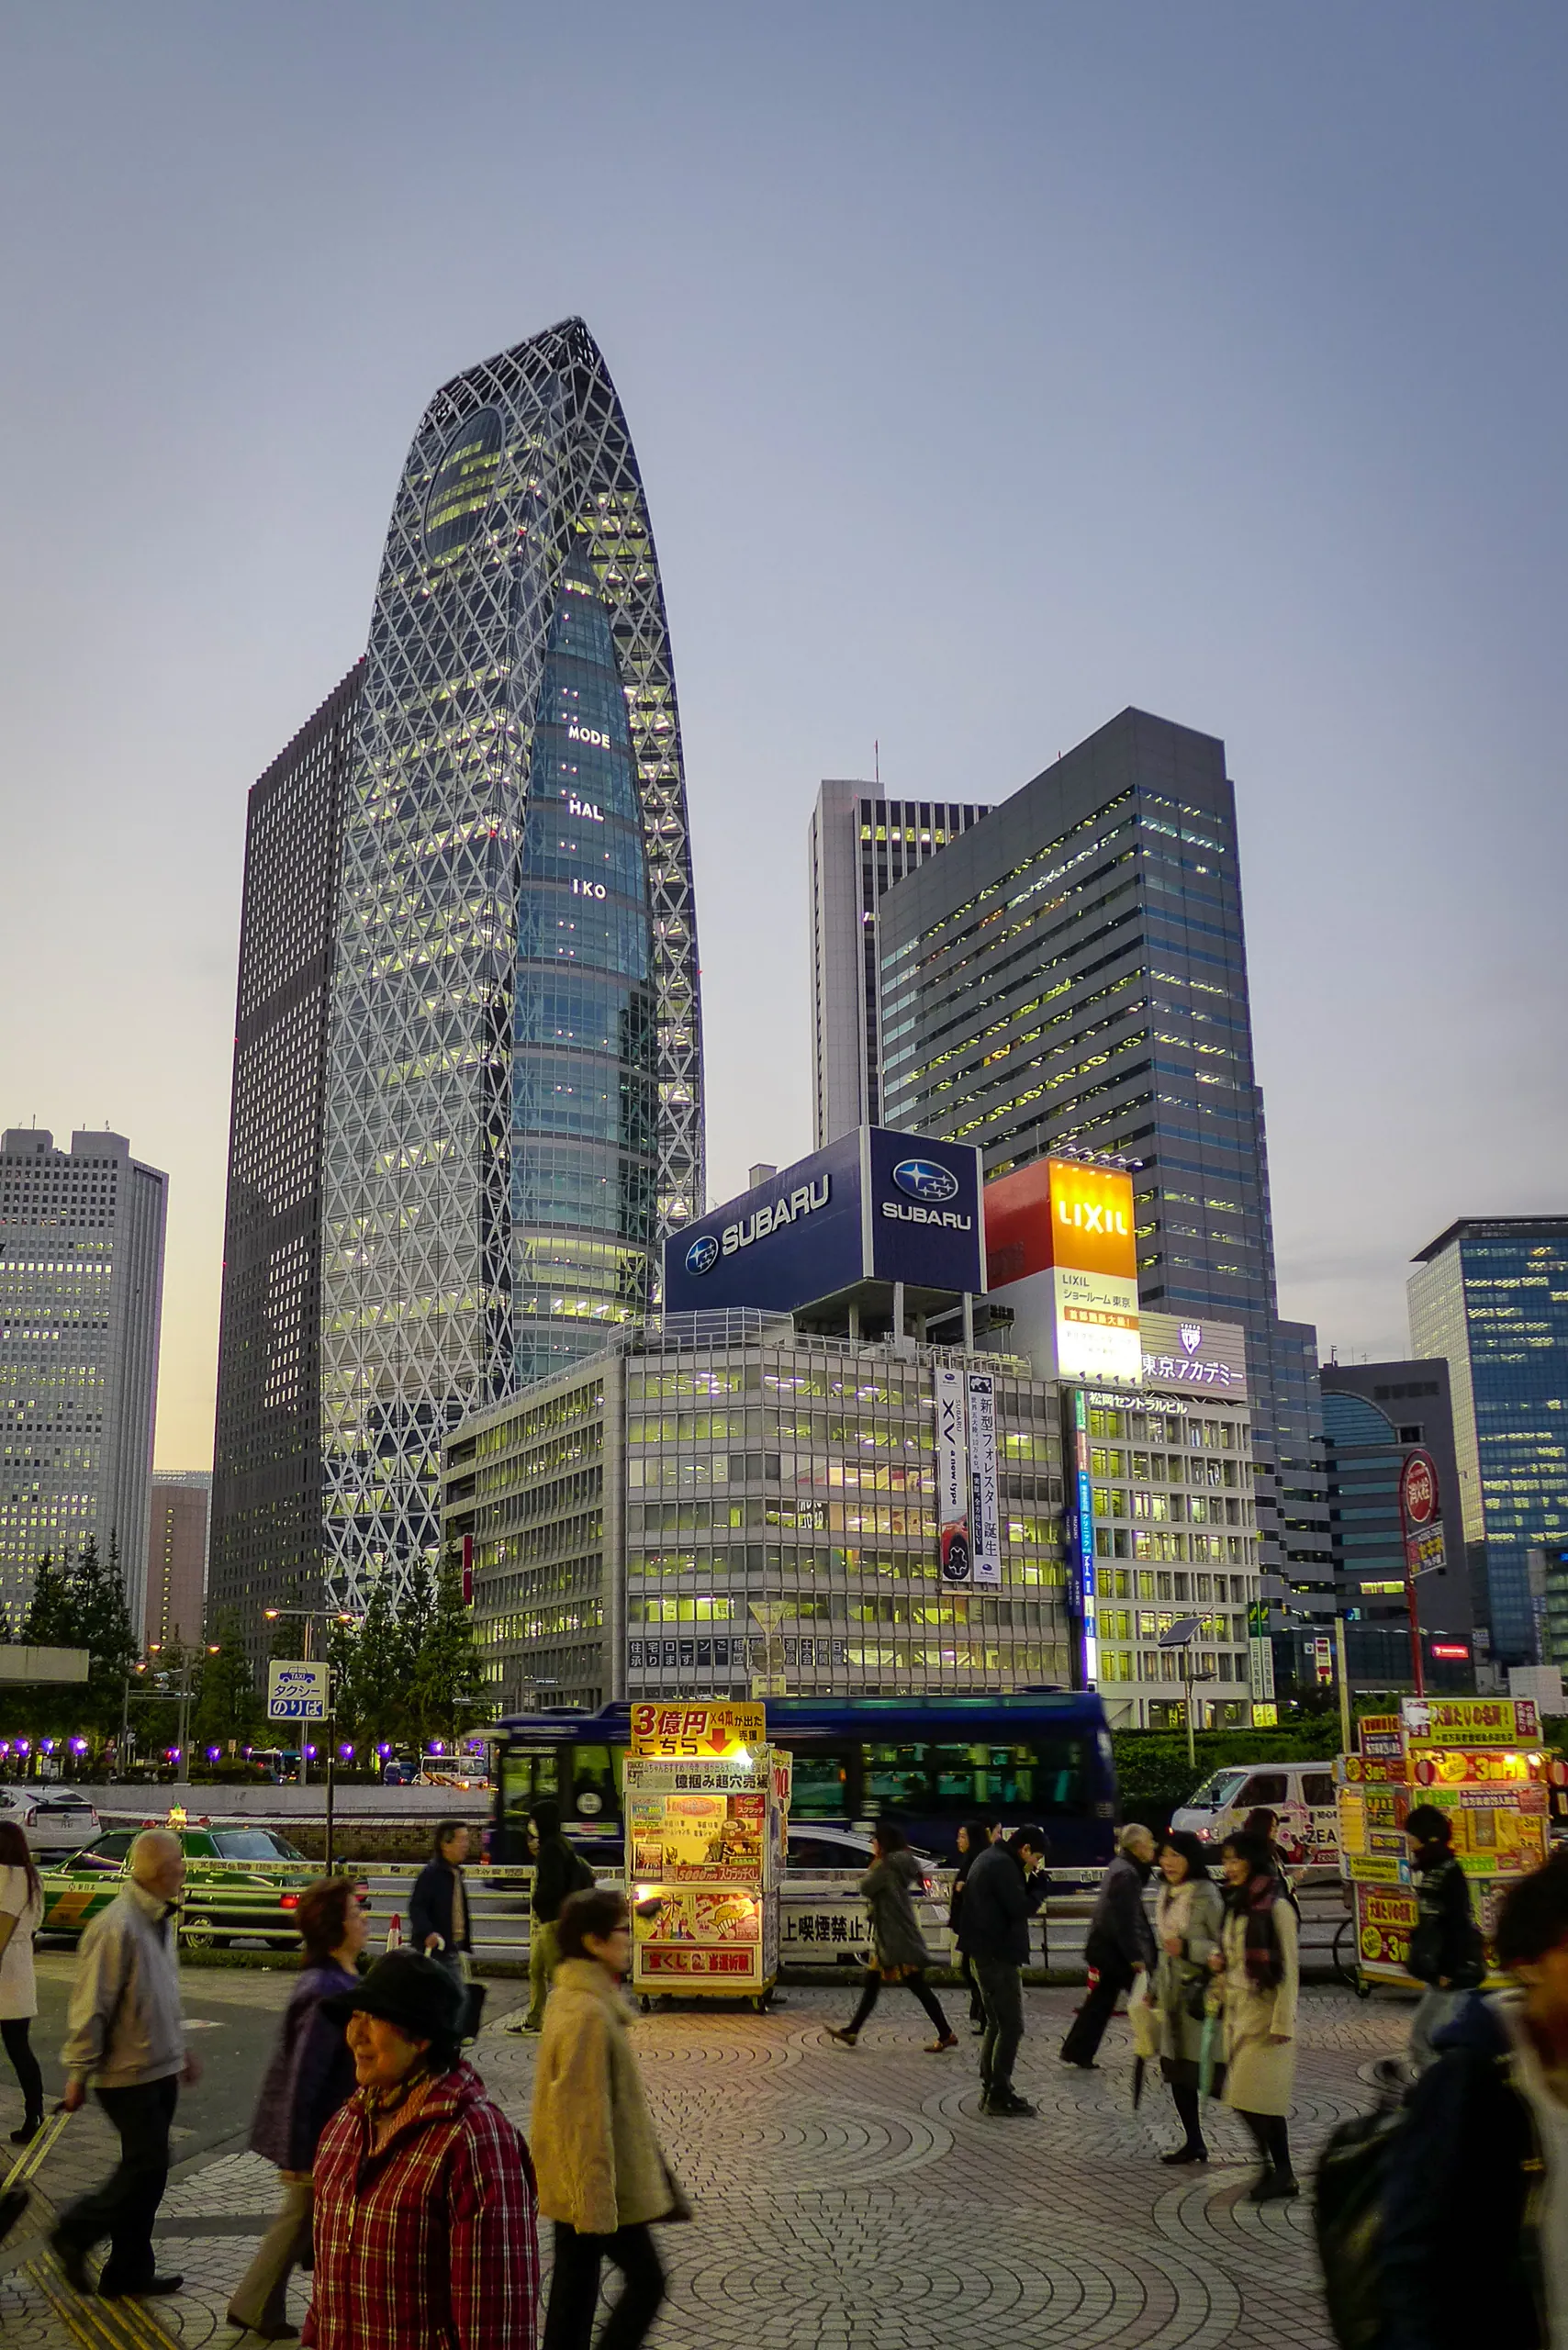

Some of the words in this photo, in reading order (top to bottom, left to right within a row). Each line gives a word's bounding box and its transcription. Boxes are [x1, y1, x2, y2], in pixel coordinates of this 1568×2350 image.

[568, 724, 611, 749] MODE
[569, 800, 604, 822] HAL
[572, 878, 606, 900] IKO
[722, 1173, 830, 1256] SUBARU
[881, 1202, 971, 1231] SUBARU
[1059, 1200, 1128, 1236] LIXIL
[1062, 1273, 1090, 1287] LIXIL
[1063, 1289, 1111, 1305] ショールーム
[1112, 1296, 1132, 1308] 東京
[1141, 1353, 1244, 1387] 東京アカデミー
[1089, 1392, 1189, 1416] 松岡セントラルビル
[942, 1398, 956, 1445] XV
[980, 1397, 998, 1557] 新型フォレスター誕生
[274, 1684, 320, 1697] タクシー
[273, 1700, 322, 1716] のりば
[633, 1705, 709, 1737] 3億円
[637, 1737, 700, 1756] こちら
[739, 1729, 757, 1741] 売場
[675, 1774, 769, 1790] 億掴み超穴売場
